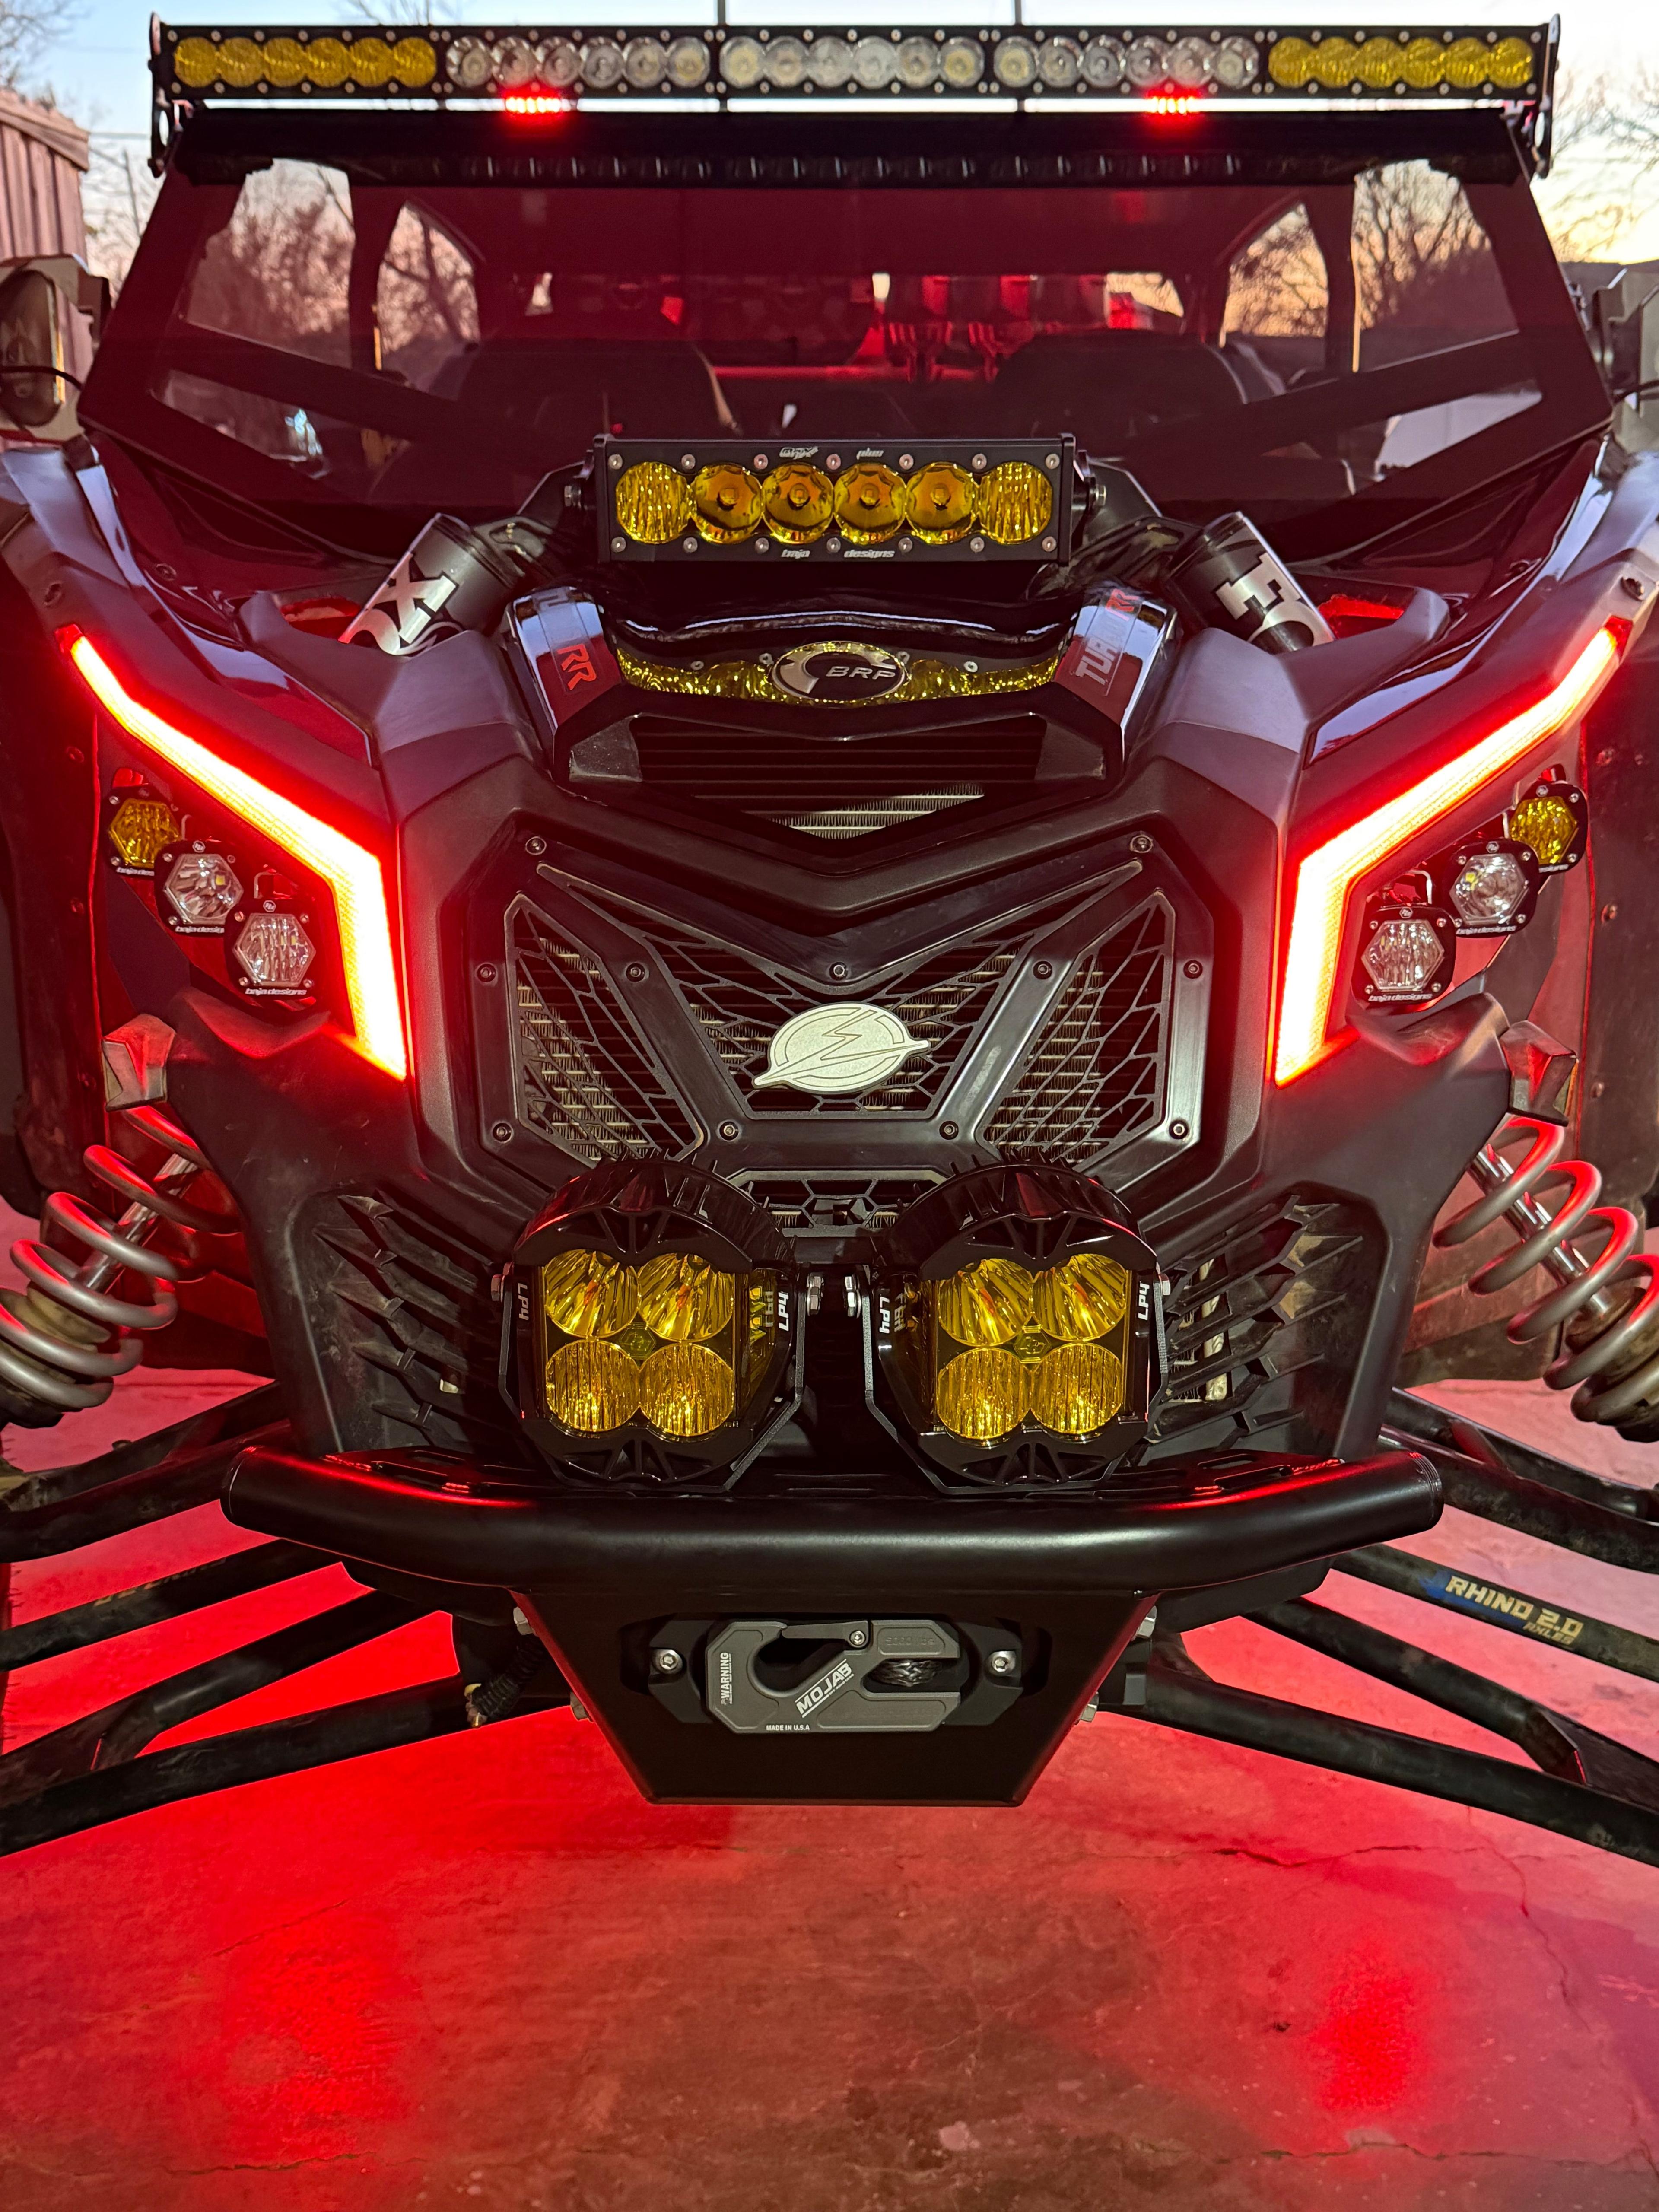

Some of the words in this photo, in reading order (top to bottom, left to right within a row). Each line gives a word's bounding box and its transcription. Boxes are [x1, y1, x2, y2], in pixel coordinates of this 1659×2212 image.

[844, 549, 895, 559] designs
[557, 643, 597, 690] RR
[826, 666, 896, 680] BRP
[518, 1283, 529, 1320] LP4
[778, 1291, 789, 1331] LP4
[879, 1296, 890, 1334] LP4
[1138, 1283, 1150, 1321] LP4
[1445, 1575, 1534, 1620] RHINO
[1536, 1608, 1584, 1638] 2.0
[720, 1652, 730, 1699] WARNING
[796, 1663, 852, 1714] MOJAB
